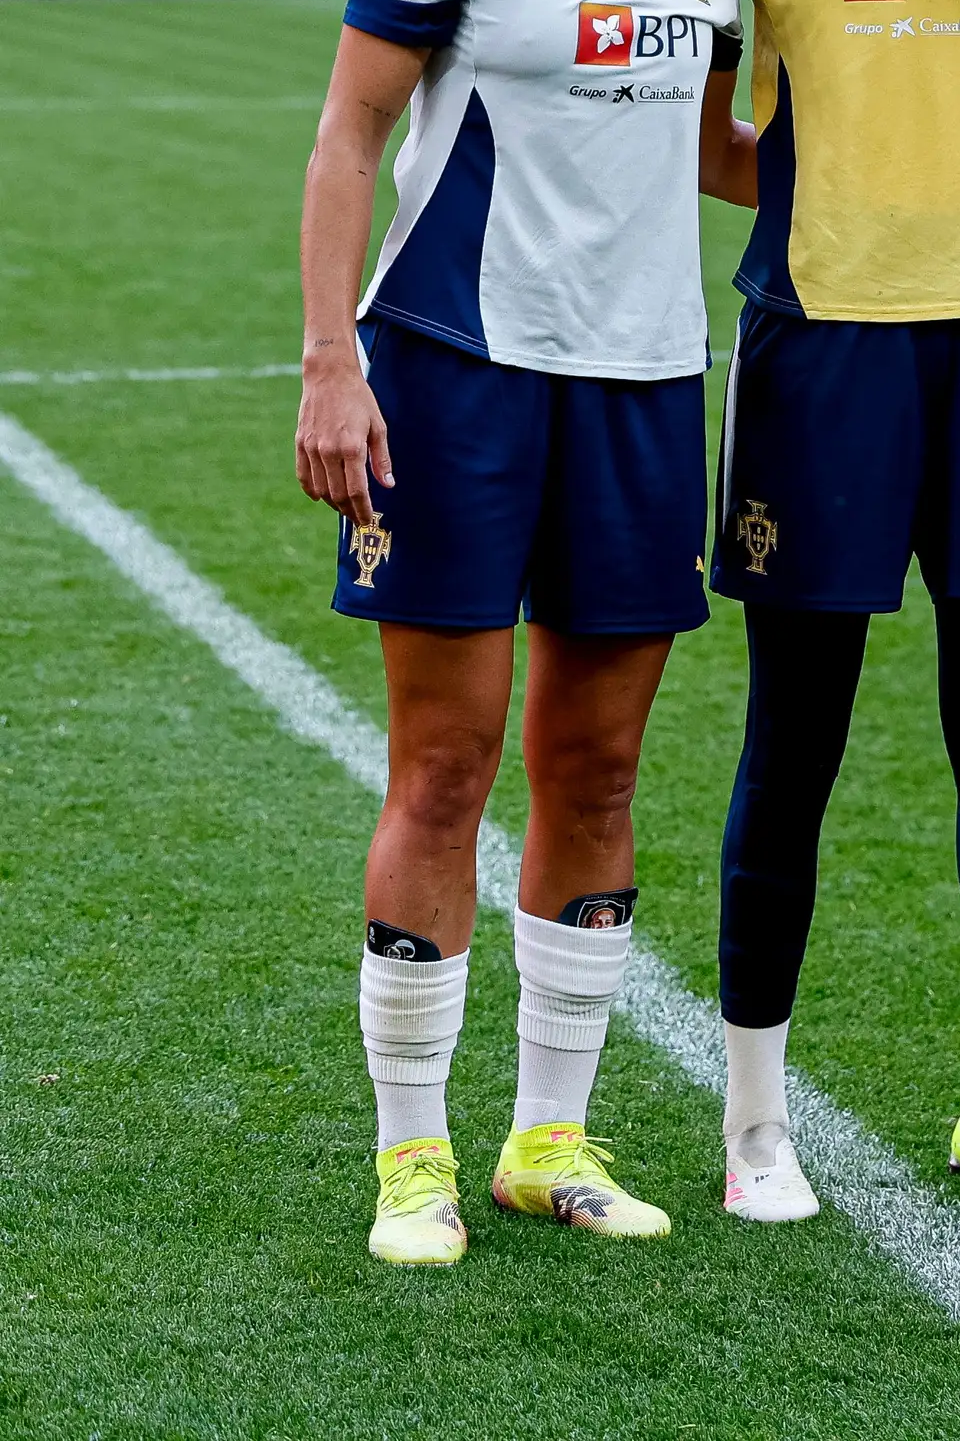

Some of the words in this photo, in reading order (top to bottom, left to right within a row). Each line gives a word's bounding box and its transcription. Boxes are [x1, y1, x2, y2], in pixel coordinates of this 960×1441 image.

[635, 14, 699, 58] BPI
[844, 23, 883, 36] Grupo
[569, 85, 607, 100] Grupo
[639, 85, 695, 100] CaixaBank
